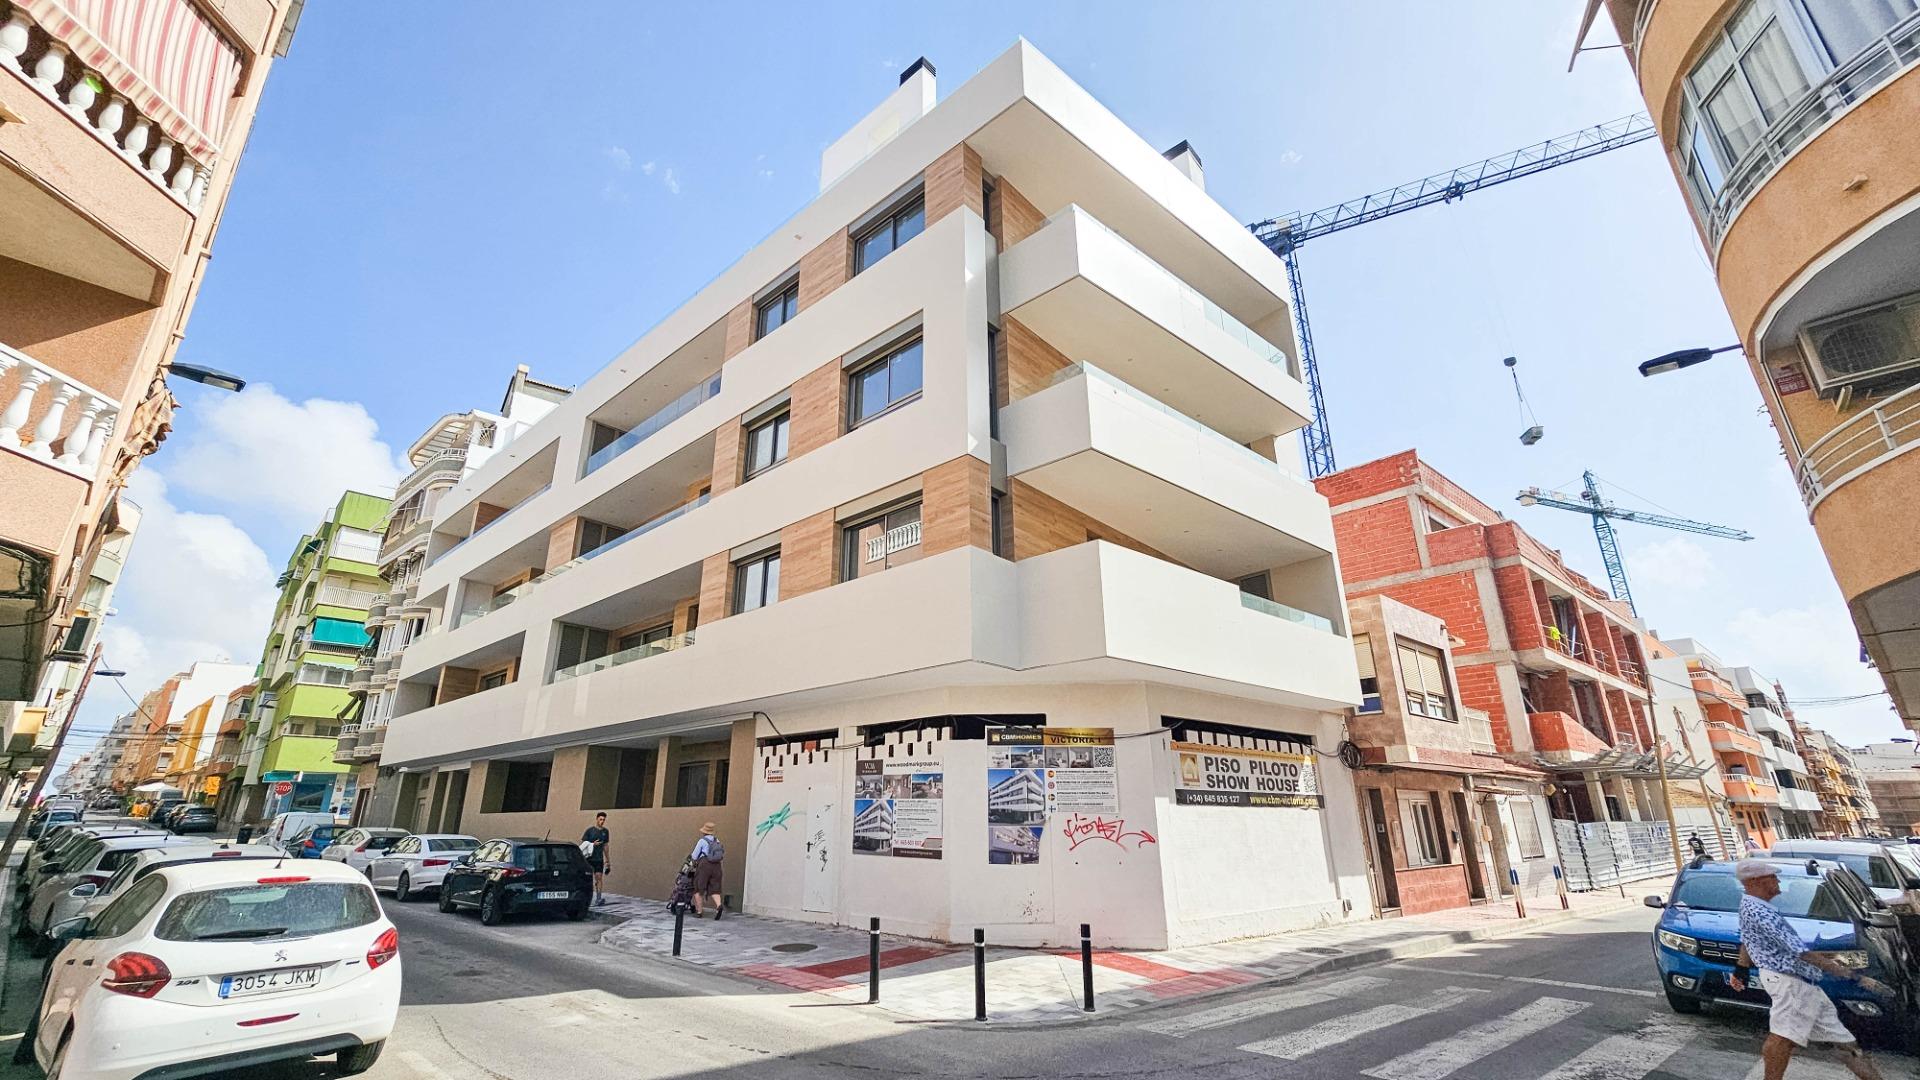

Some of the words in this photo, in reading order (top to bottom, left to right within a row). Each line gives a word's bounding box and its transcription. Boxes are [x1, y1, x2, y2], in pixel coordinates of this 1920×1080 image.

[1203, 756, 1241, 773] PISO
[1249, 759, 1298, 777] PILOTO
[1206, 774, 1250, 789] SHOW
[1256, 777, 1300, 792] HOUSE
[233, 973, 278, 992] 3054
[285, 969, 316, 985] JKM
